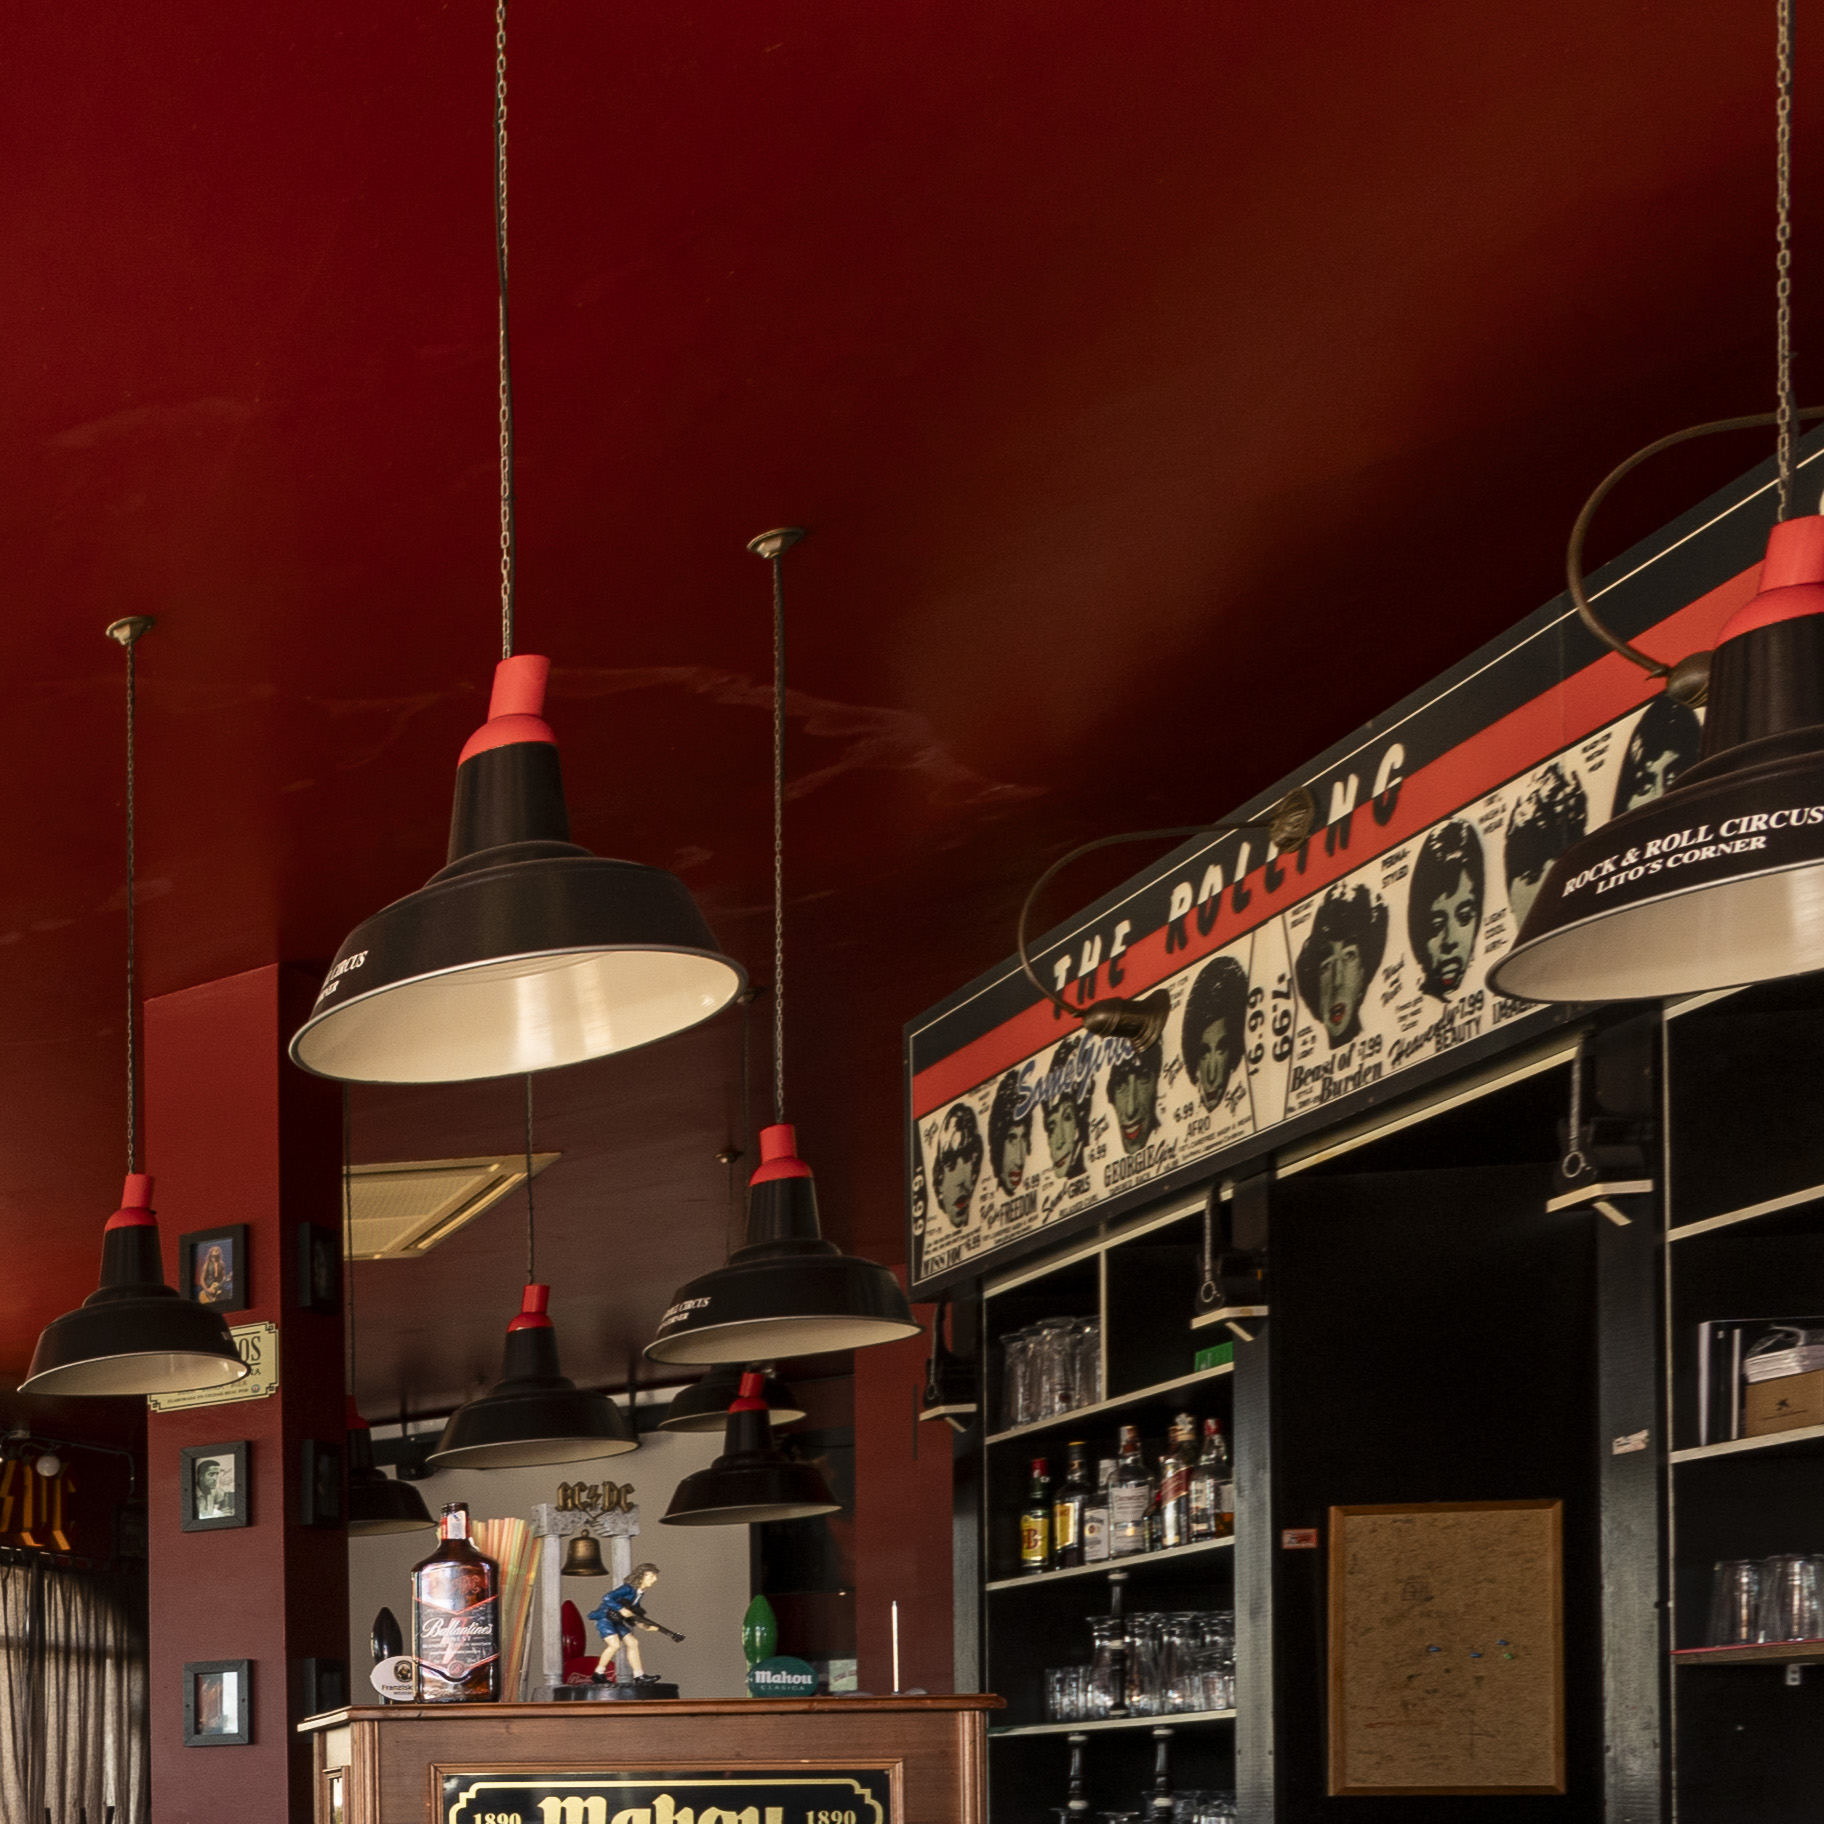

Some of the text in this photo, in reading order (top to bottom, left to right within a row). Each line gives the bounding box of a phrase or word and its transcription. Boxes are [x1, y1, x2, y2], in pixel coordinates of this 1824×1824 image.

[1561, 806, 1824, 898] ROCK & ROLL CIRCUS
[1665, 835, 1767, 869] CORNER
[1053, 919, 1133, 1019] THE
[1435, 1018, 1482, 1052] BEAUTY
[1291, 1041, 1356, 1092] Beast of
[1320, 1060, 1383, 1103] Burden
[1014, 1059, 1075, 1120] Some
[1185, 1117, 1212, 1142] AFRO
[1104, 1146, 1156, 1188] GEORGIE
[421, 1617, 494, 1638] Ballantine's
[753, 1670, 814, 1686] Mahou
